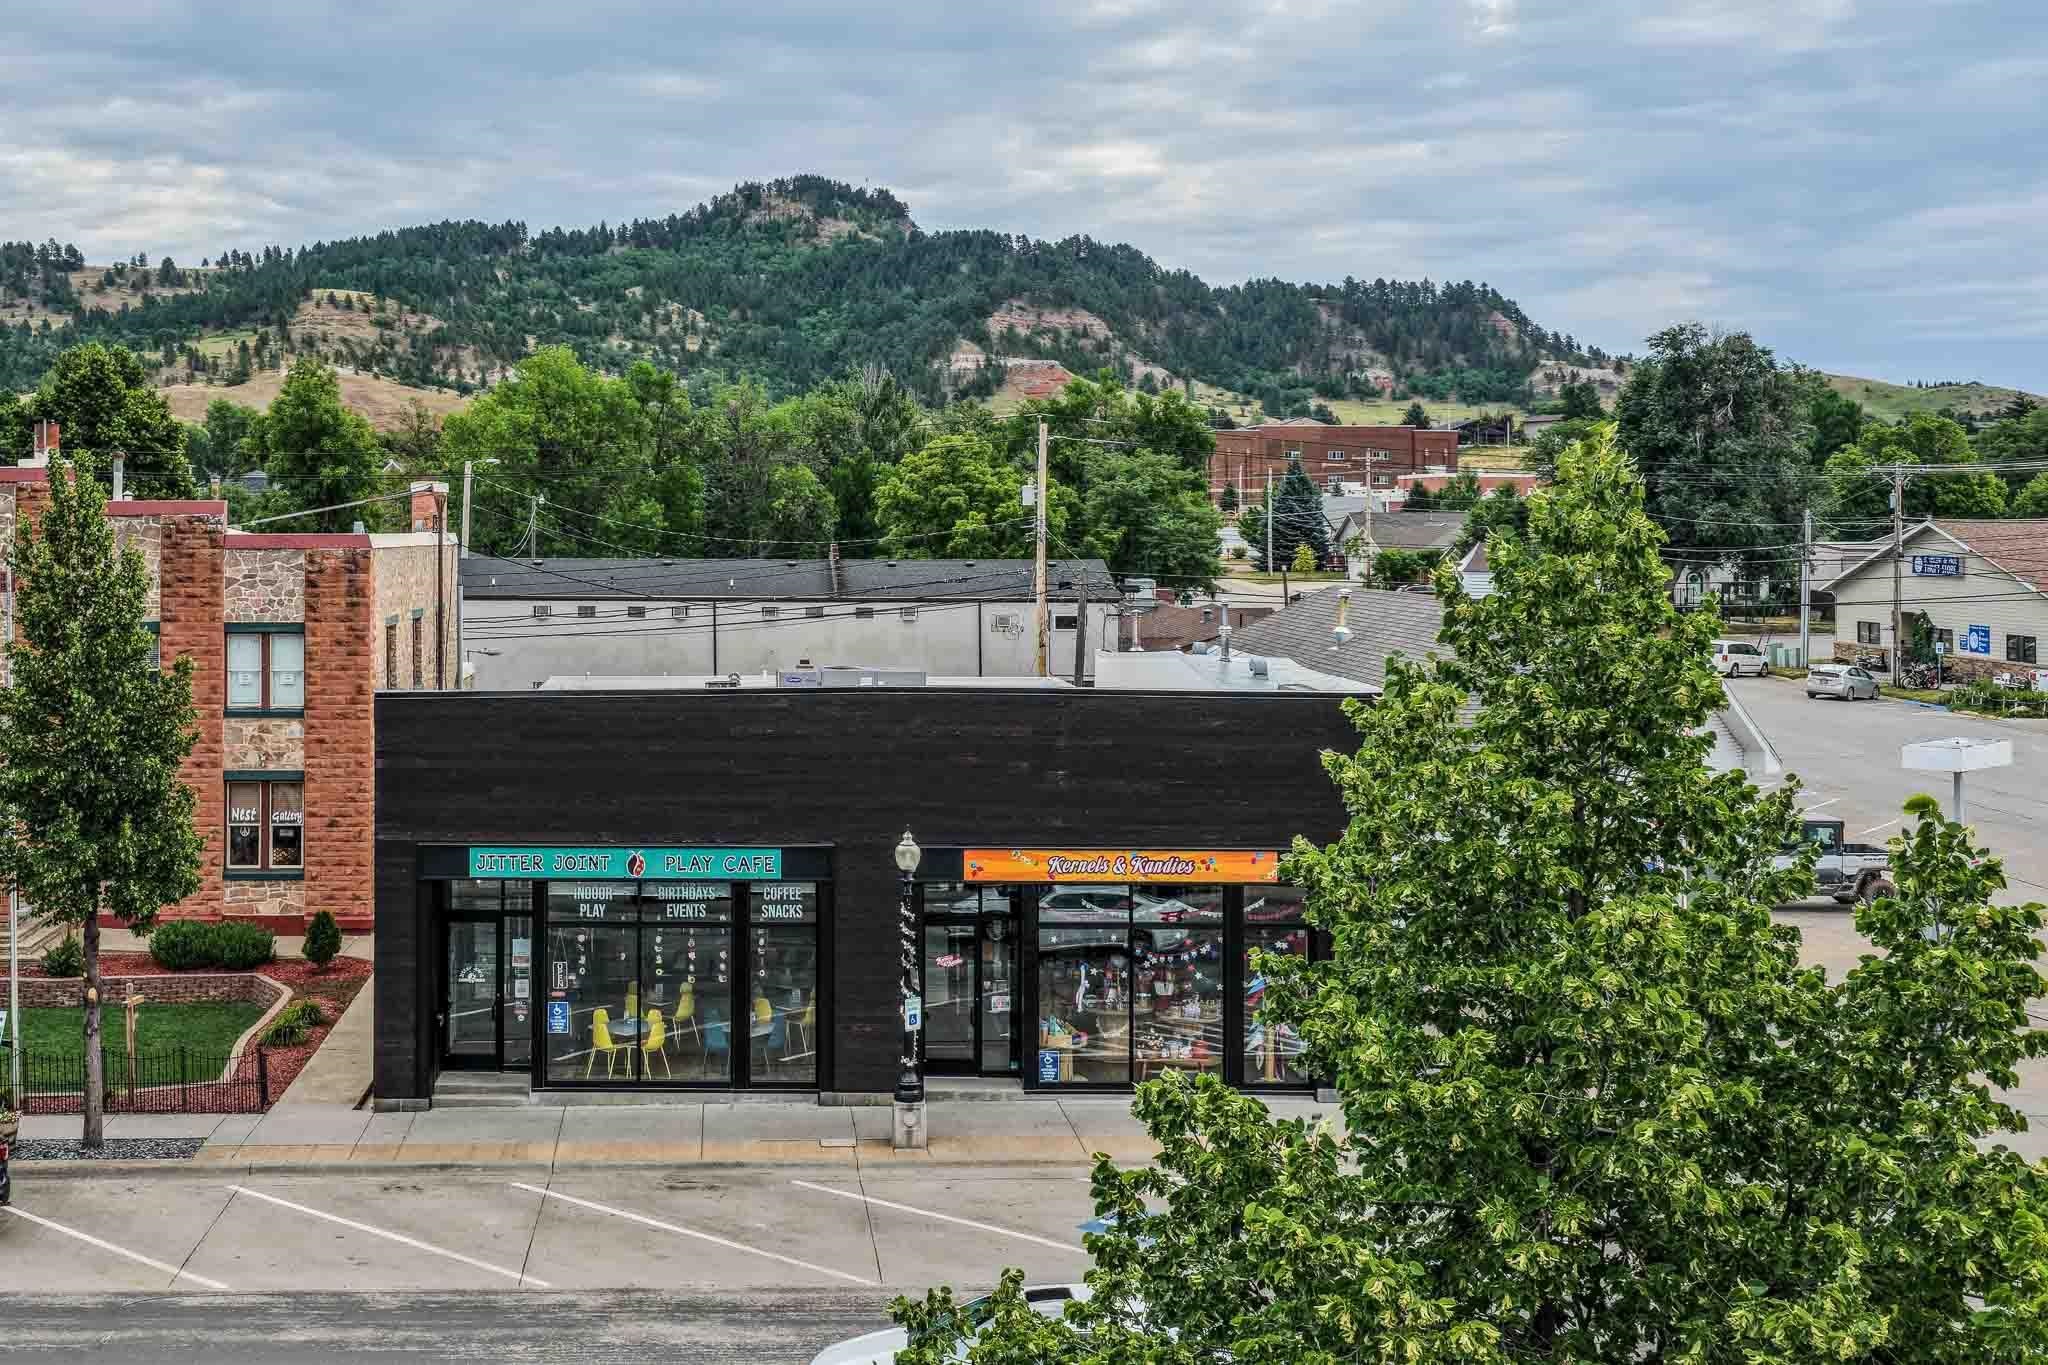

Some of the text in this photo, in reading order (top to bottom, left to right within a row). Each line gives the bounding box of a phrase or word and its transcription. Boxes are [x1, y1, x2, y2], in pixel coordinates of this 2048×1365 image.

[231, 807, 257, 821] Nest
[476, 853, 776, 873] JITTER JOINT PLAY CAFE
[1048, 855, 1195, 875] Kernels & Kandies
[658, 886, 716, 900] BIRTHDAYS
[763, 887, 801, 900] COFFEE
[579, 903, 606, 918] PLAY
[666, 903, 706, 918] EVENTS
[761, 904, 803, 918] SNACKS
